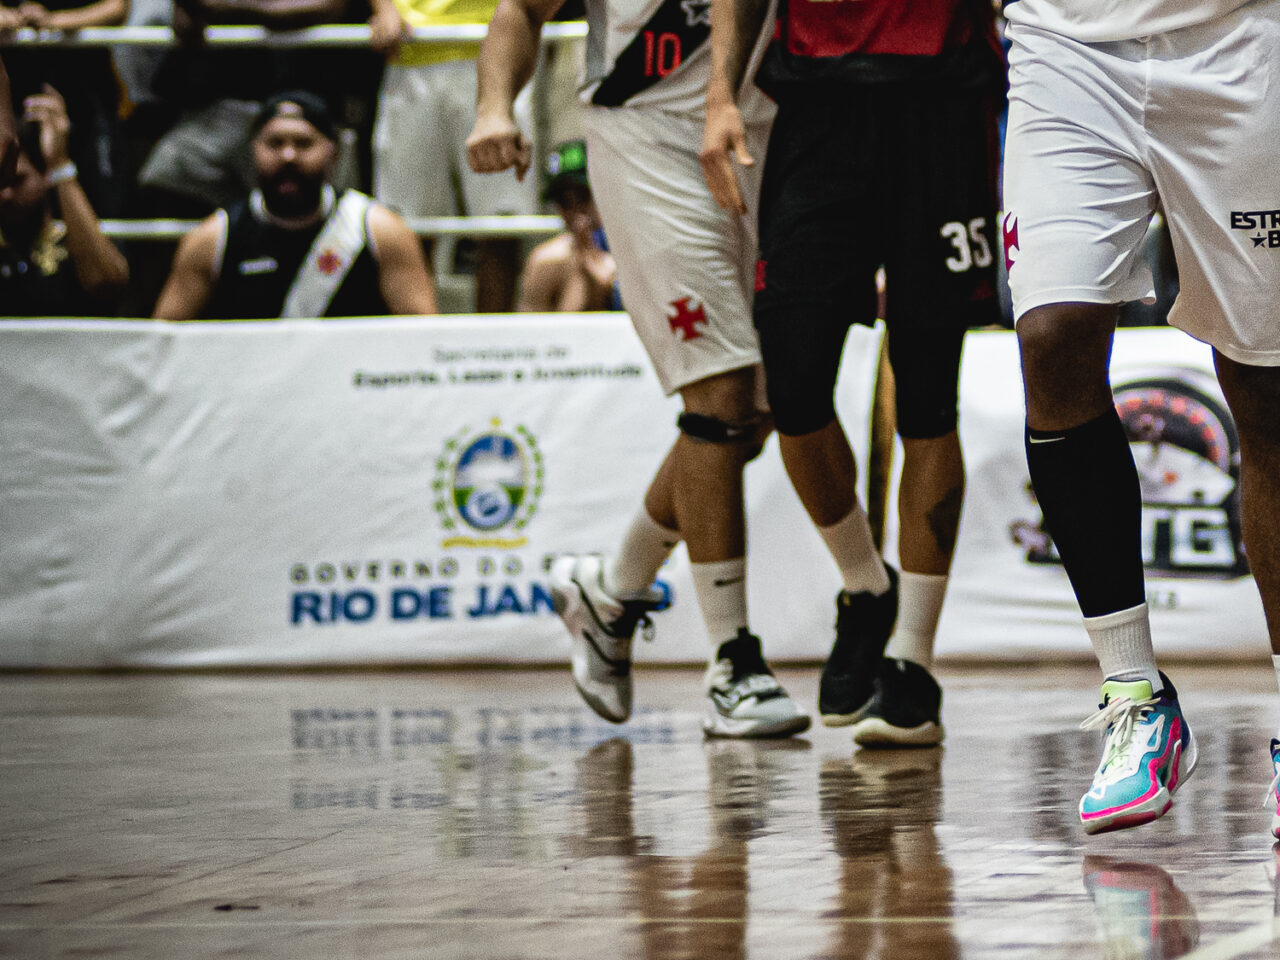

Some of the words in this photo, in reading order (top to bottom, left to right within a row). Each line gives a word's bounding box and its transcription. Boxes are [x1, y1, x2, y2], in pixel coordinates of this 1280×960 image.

[643, 30, 682, 78] 10
[940, 217, 993, 272] 35
[290, 556, 459, 585] GOVERNO
[477, 555, 524, 577] DO
[289, 589, 378, 626] RIO
[389, 585, 453, 619] DE
